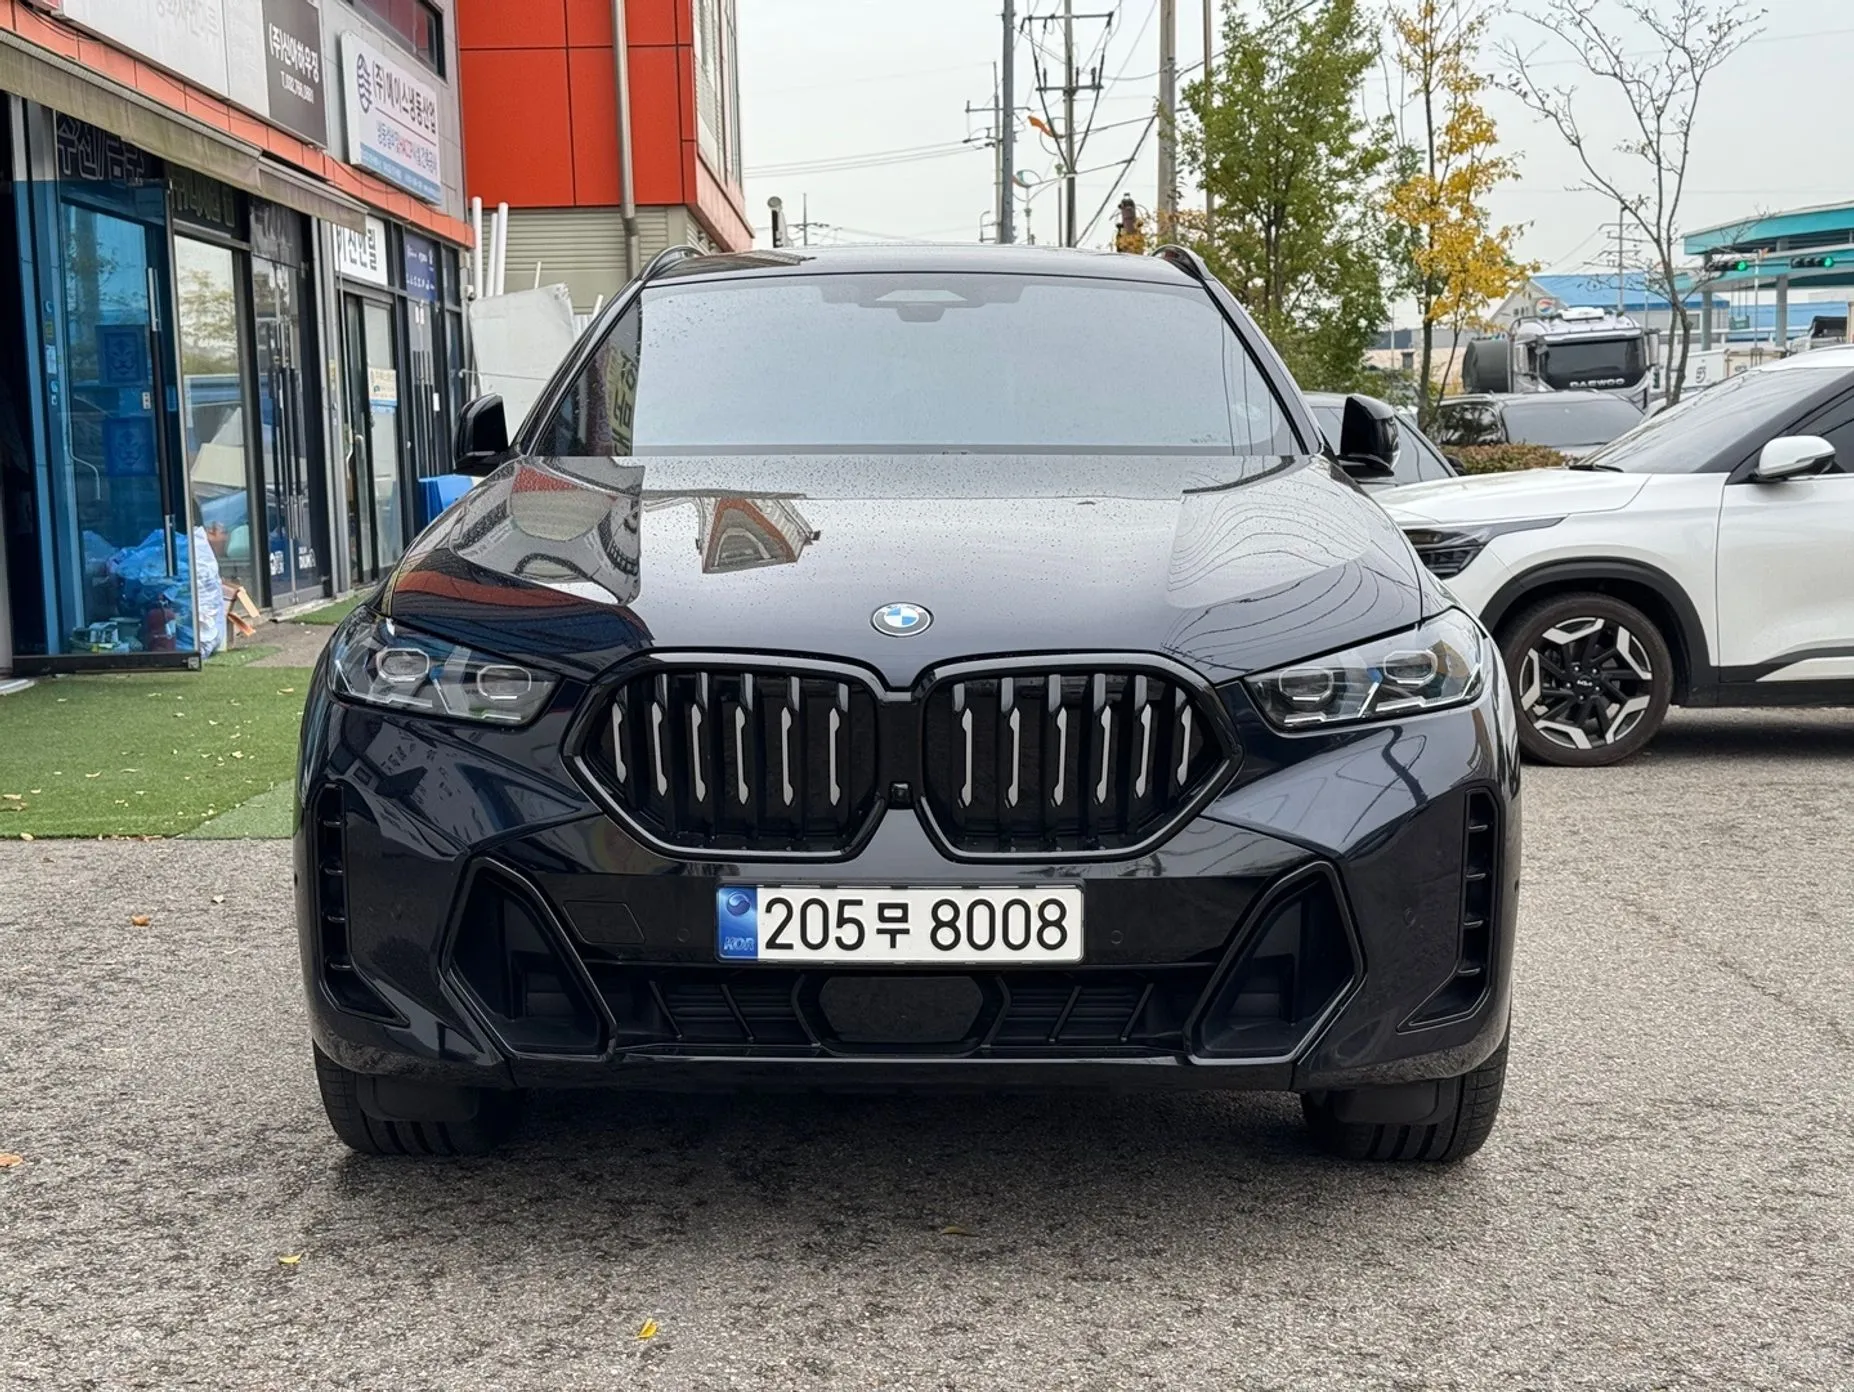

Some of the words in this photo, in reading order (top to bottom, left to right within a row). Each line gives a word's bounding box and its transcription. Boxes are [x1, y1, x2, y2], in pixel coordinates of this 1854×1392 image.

[268, 22, 319, 83] (주)신아하우징
[373, 60, 437, 135] (주)에이스냉동산업
[1569, 378, 1625, 388] DAEWOO
[723, 936, 755, 951] KOR
[764, 897, 911, 951] 205무
[929, 898, 1068, 952] 8008
